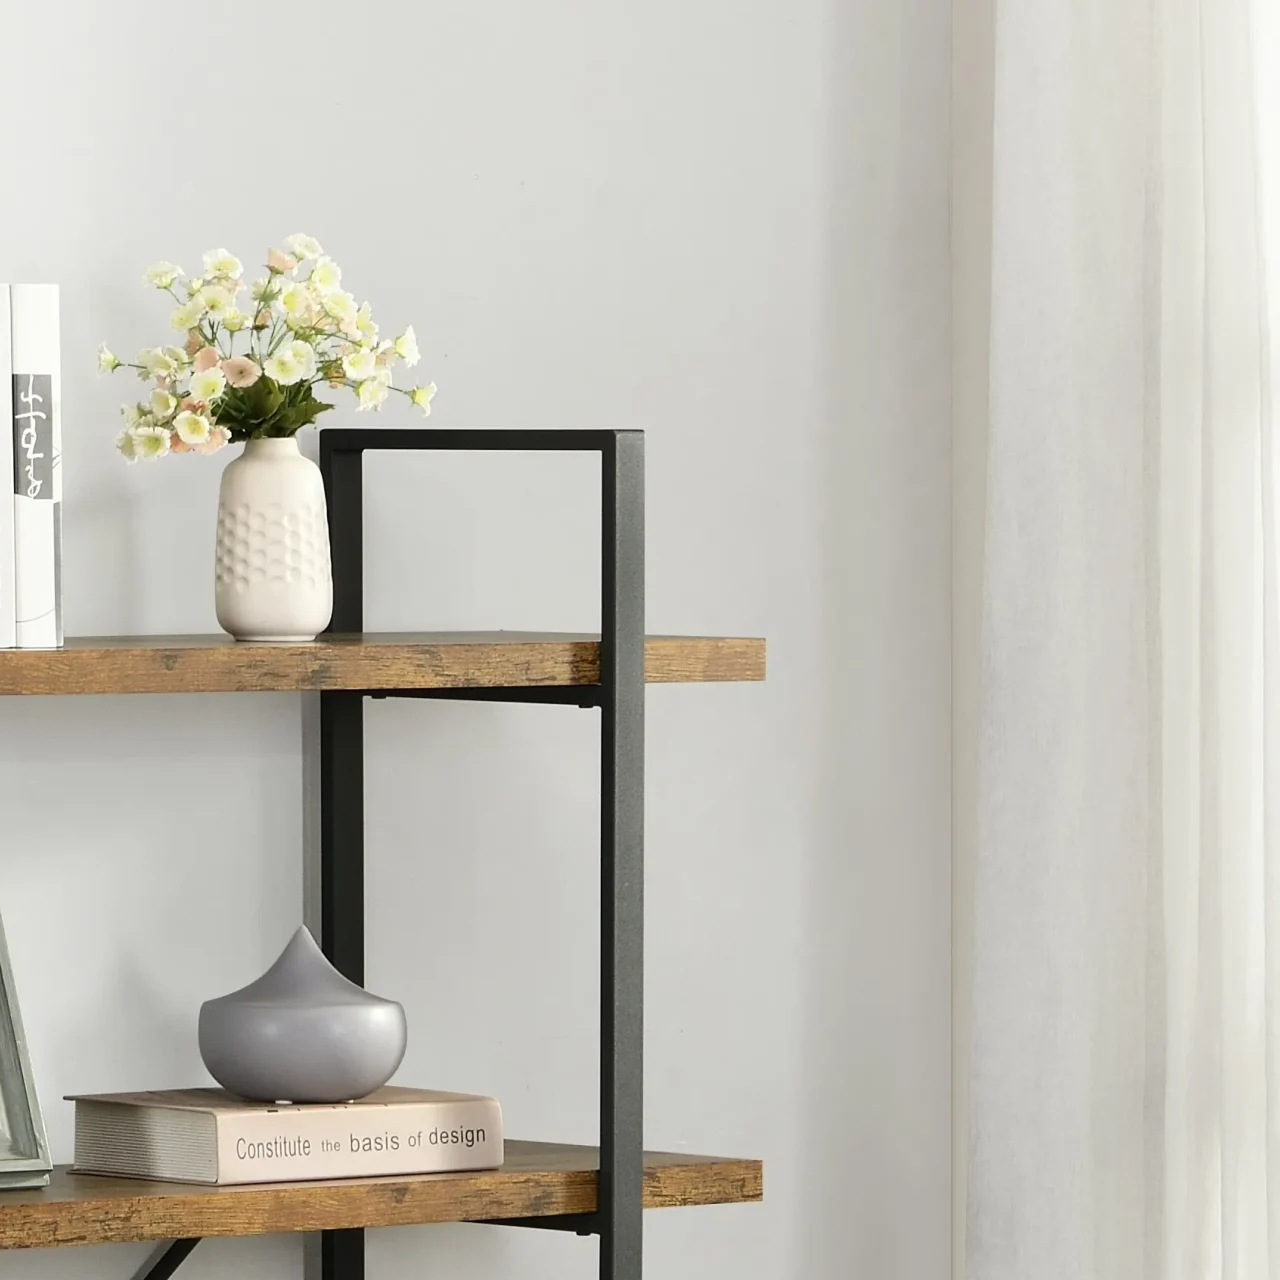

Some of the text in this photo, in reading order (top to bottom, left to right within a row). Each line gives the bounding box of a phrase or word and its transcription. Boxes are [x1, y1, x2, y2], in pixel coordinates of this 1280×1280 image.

[236, 1125, 486, 1160] Constitute the basis of design
